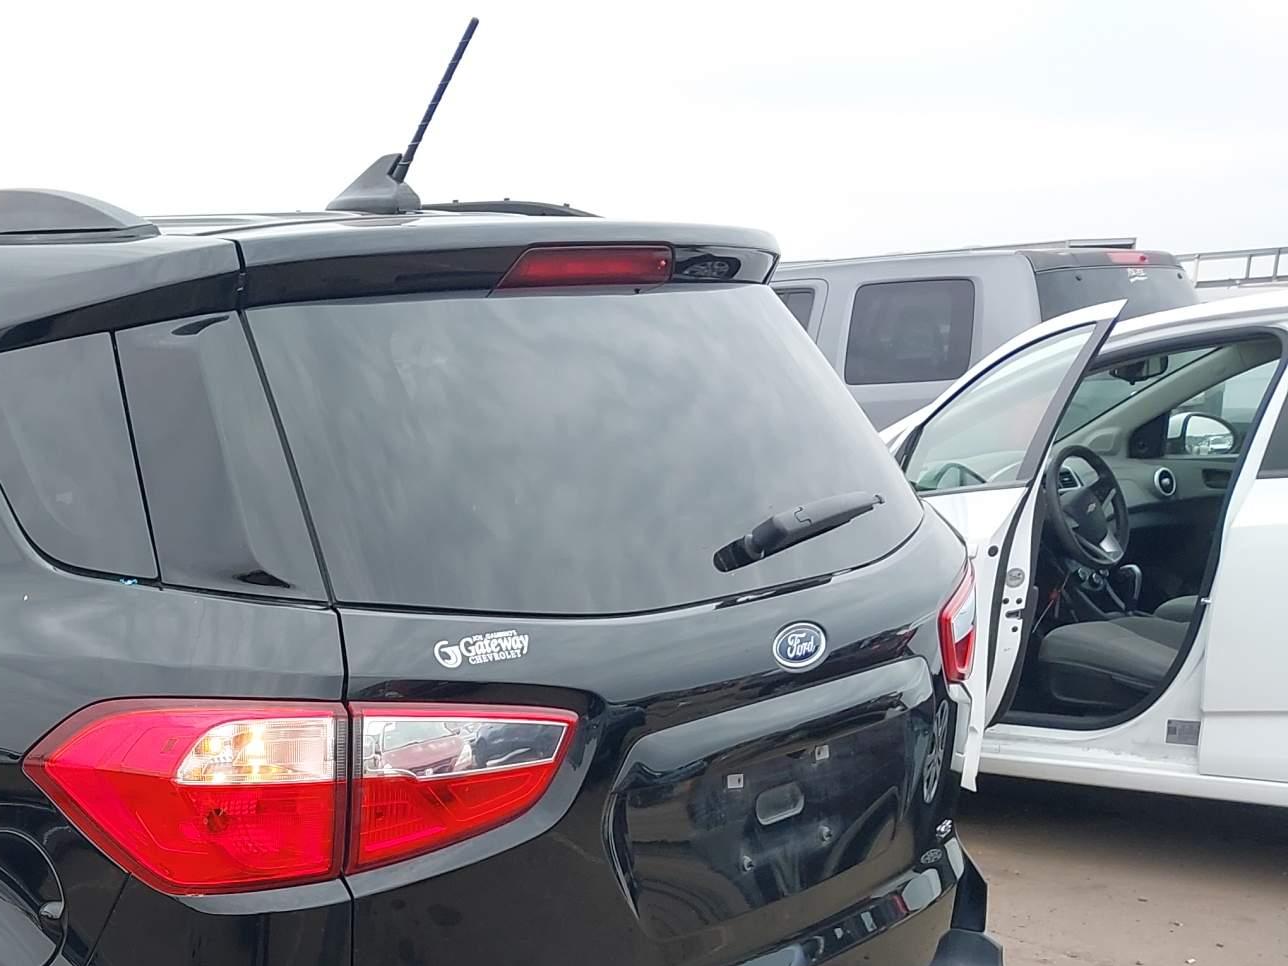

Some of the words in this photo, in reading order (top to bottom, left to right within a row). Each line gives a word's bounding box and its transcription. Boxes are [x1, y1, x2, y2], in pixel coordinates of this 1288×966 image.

[460, 634, 529, 657] Gateway
[469, 649, 522, 665] CHEVROLET
[786, 632, 816, 659] Ford
